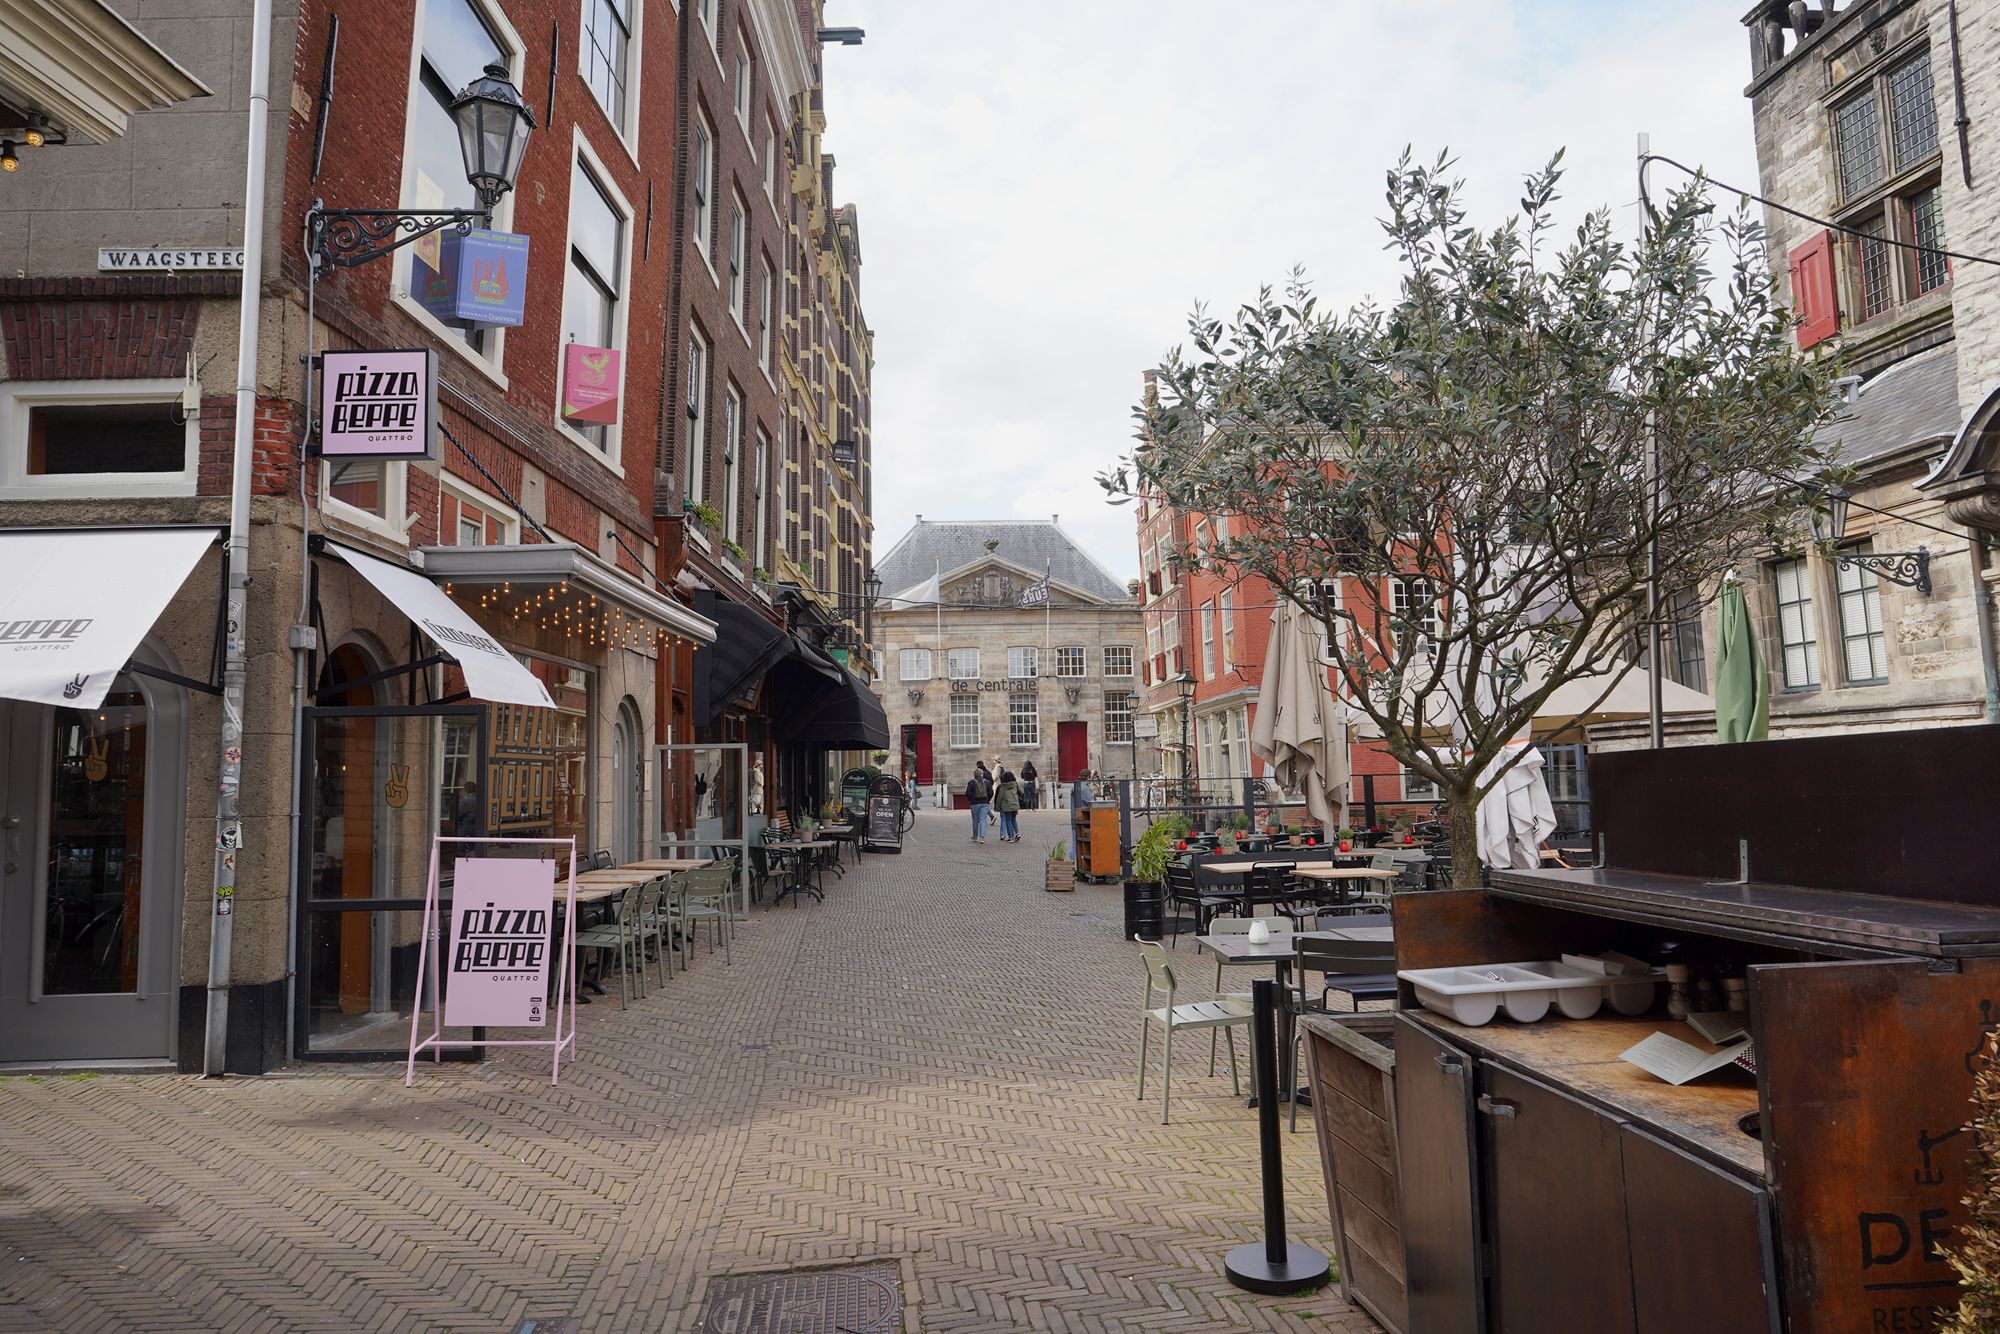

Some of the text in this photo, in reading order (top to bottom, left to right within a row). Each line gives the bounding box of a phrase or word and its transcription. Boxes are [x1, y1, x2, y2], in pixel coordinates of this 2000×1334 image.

[108, 252, 244, 266] WAAGSTEEG
[335, 366, 418, 402] pizza
[14, 644, 70, 652] QUATTRO
[951, 678, 1037, 692] de centrale
[459, 902, 546, 940] pizza
